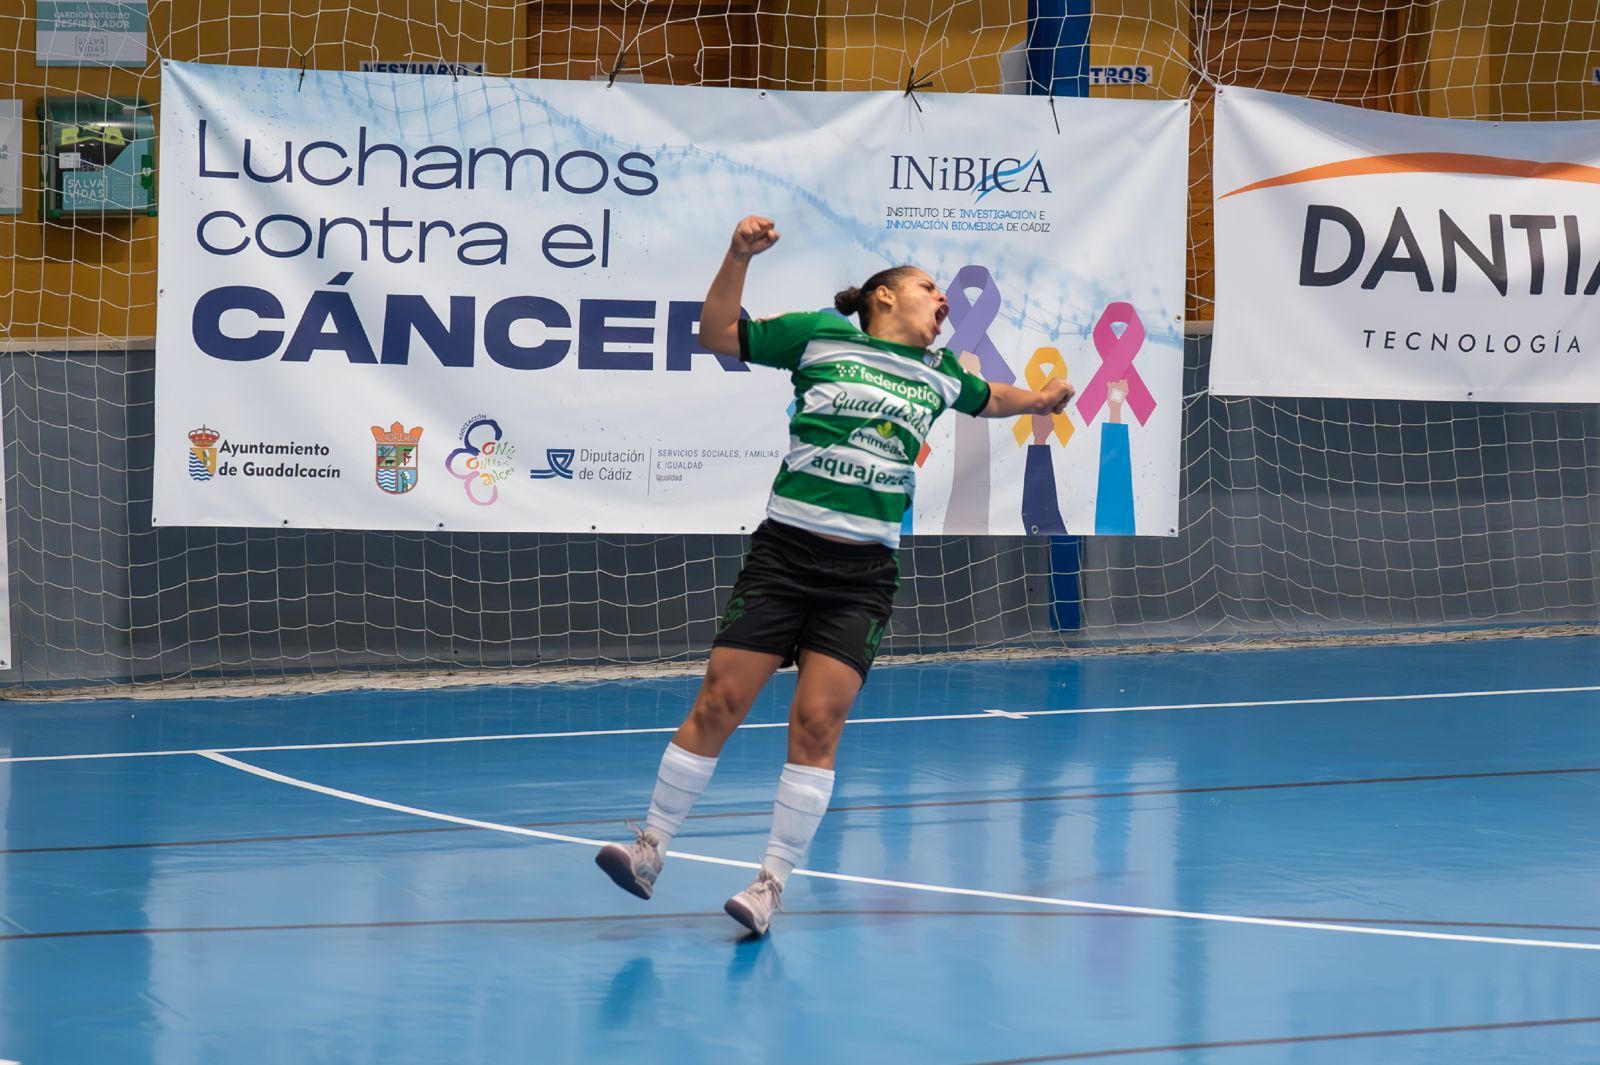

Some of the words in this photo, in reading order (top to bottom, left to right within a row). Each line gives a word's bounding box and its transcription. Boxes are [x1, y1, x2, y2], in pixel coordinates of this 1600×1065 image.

[198, 118, 659, 197] Luchamos
[68, 179, 105, 189] SALVA
[886, 206, 940, 218] INSTITUTO
[942, 207, 956, 218] DE
[959, 208, 1037, 220] INVESTIGACIÓN
[1039, 210, 1046, 220] E
[886, 219, 949, 230] INNOVACIÓN
[1006, 222, 1019, 232] DE
[1020, 221, 1051, 233] CÁDIZ
[196, 206, 508, 266] contra
[541, 208, 611, 268] el
[1298, 204, 1600, 297] DANTI
[191, 271, 752, 373] CÁNCER
[1363, 329, 1581, 354] TECNOLOGÍA
[218, 439, 330, 458] Ayuntamiento
[657, 449, 699, 458] SERVICIOS
[701, 449, 742, 459] SOCIALES,
[744, 450, 780, 458] FAMILIAS
[580, 449, 645, 464] Diputación
[218, 461, 238, 476] de
[242, 461, 341, 478] Guadalcacín
[656, 461, 661, 470] E
[664, 461, 704, 470] IGUALDAD
[578, 467, 594, 480] de
[598, 467, 632, 481] Cádiz
[655, 473, 683, 482] Igualdad
